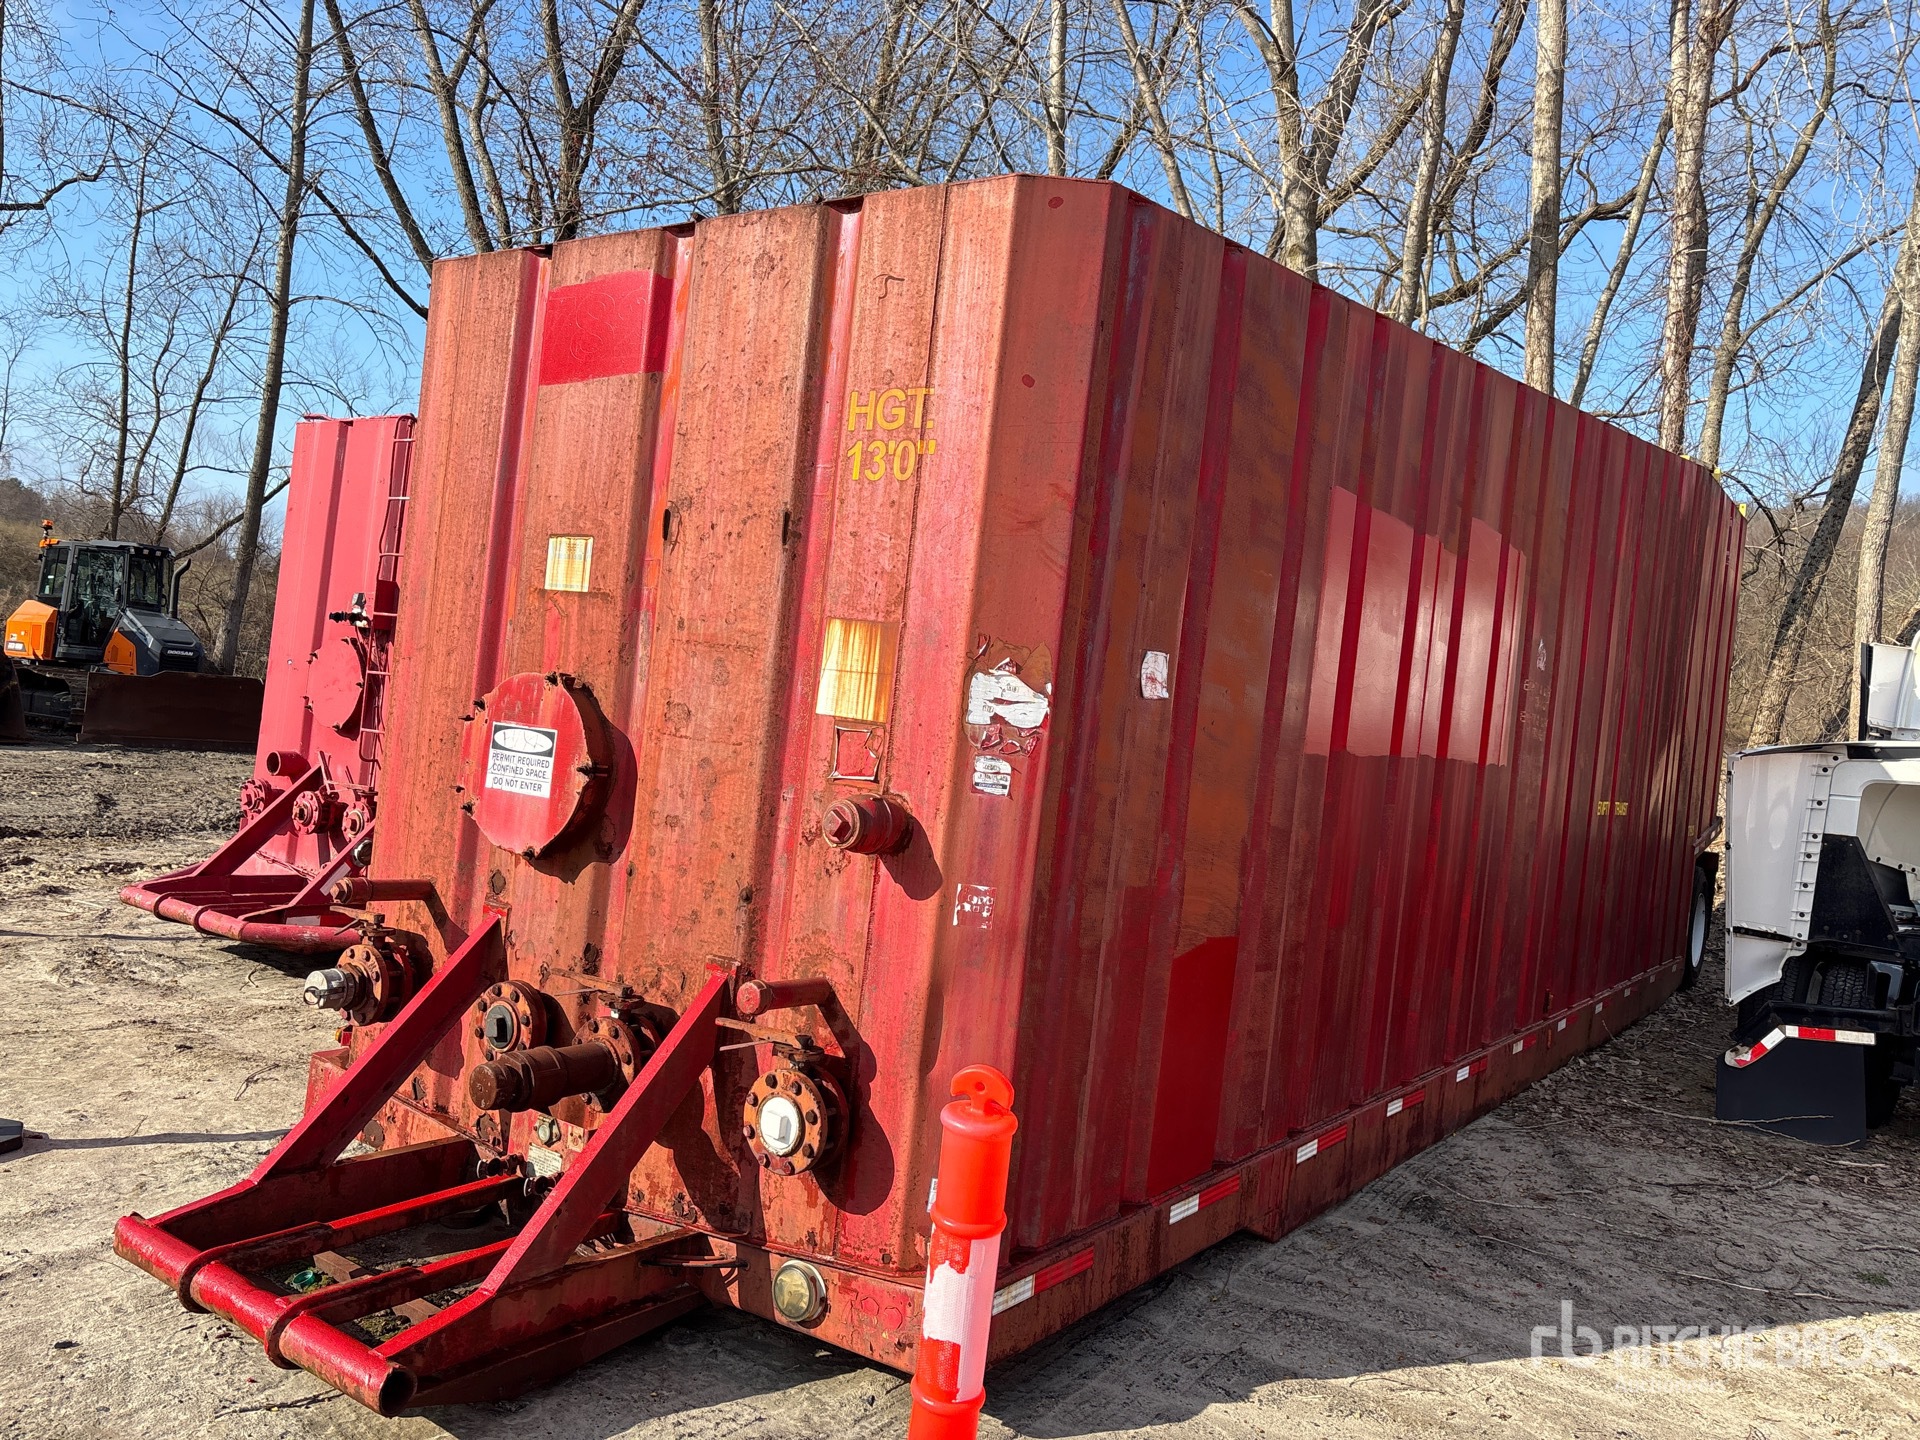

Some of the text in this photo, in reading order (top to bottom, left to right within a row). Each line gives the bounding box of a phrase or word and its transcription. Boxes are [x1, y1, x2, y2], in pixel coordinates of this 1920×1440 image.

[847, 387, 935, 431] HGT.
[847, 439, 936, 481] 13'0"
[492, 752, 550, 769] PERMIT REQUIRED
[492, 763, 547, 779] CONFINED SPACE
[493, 777, 542, 792] DO NOT ENTER
